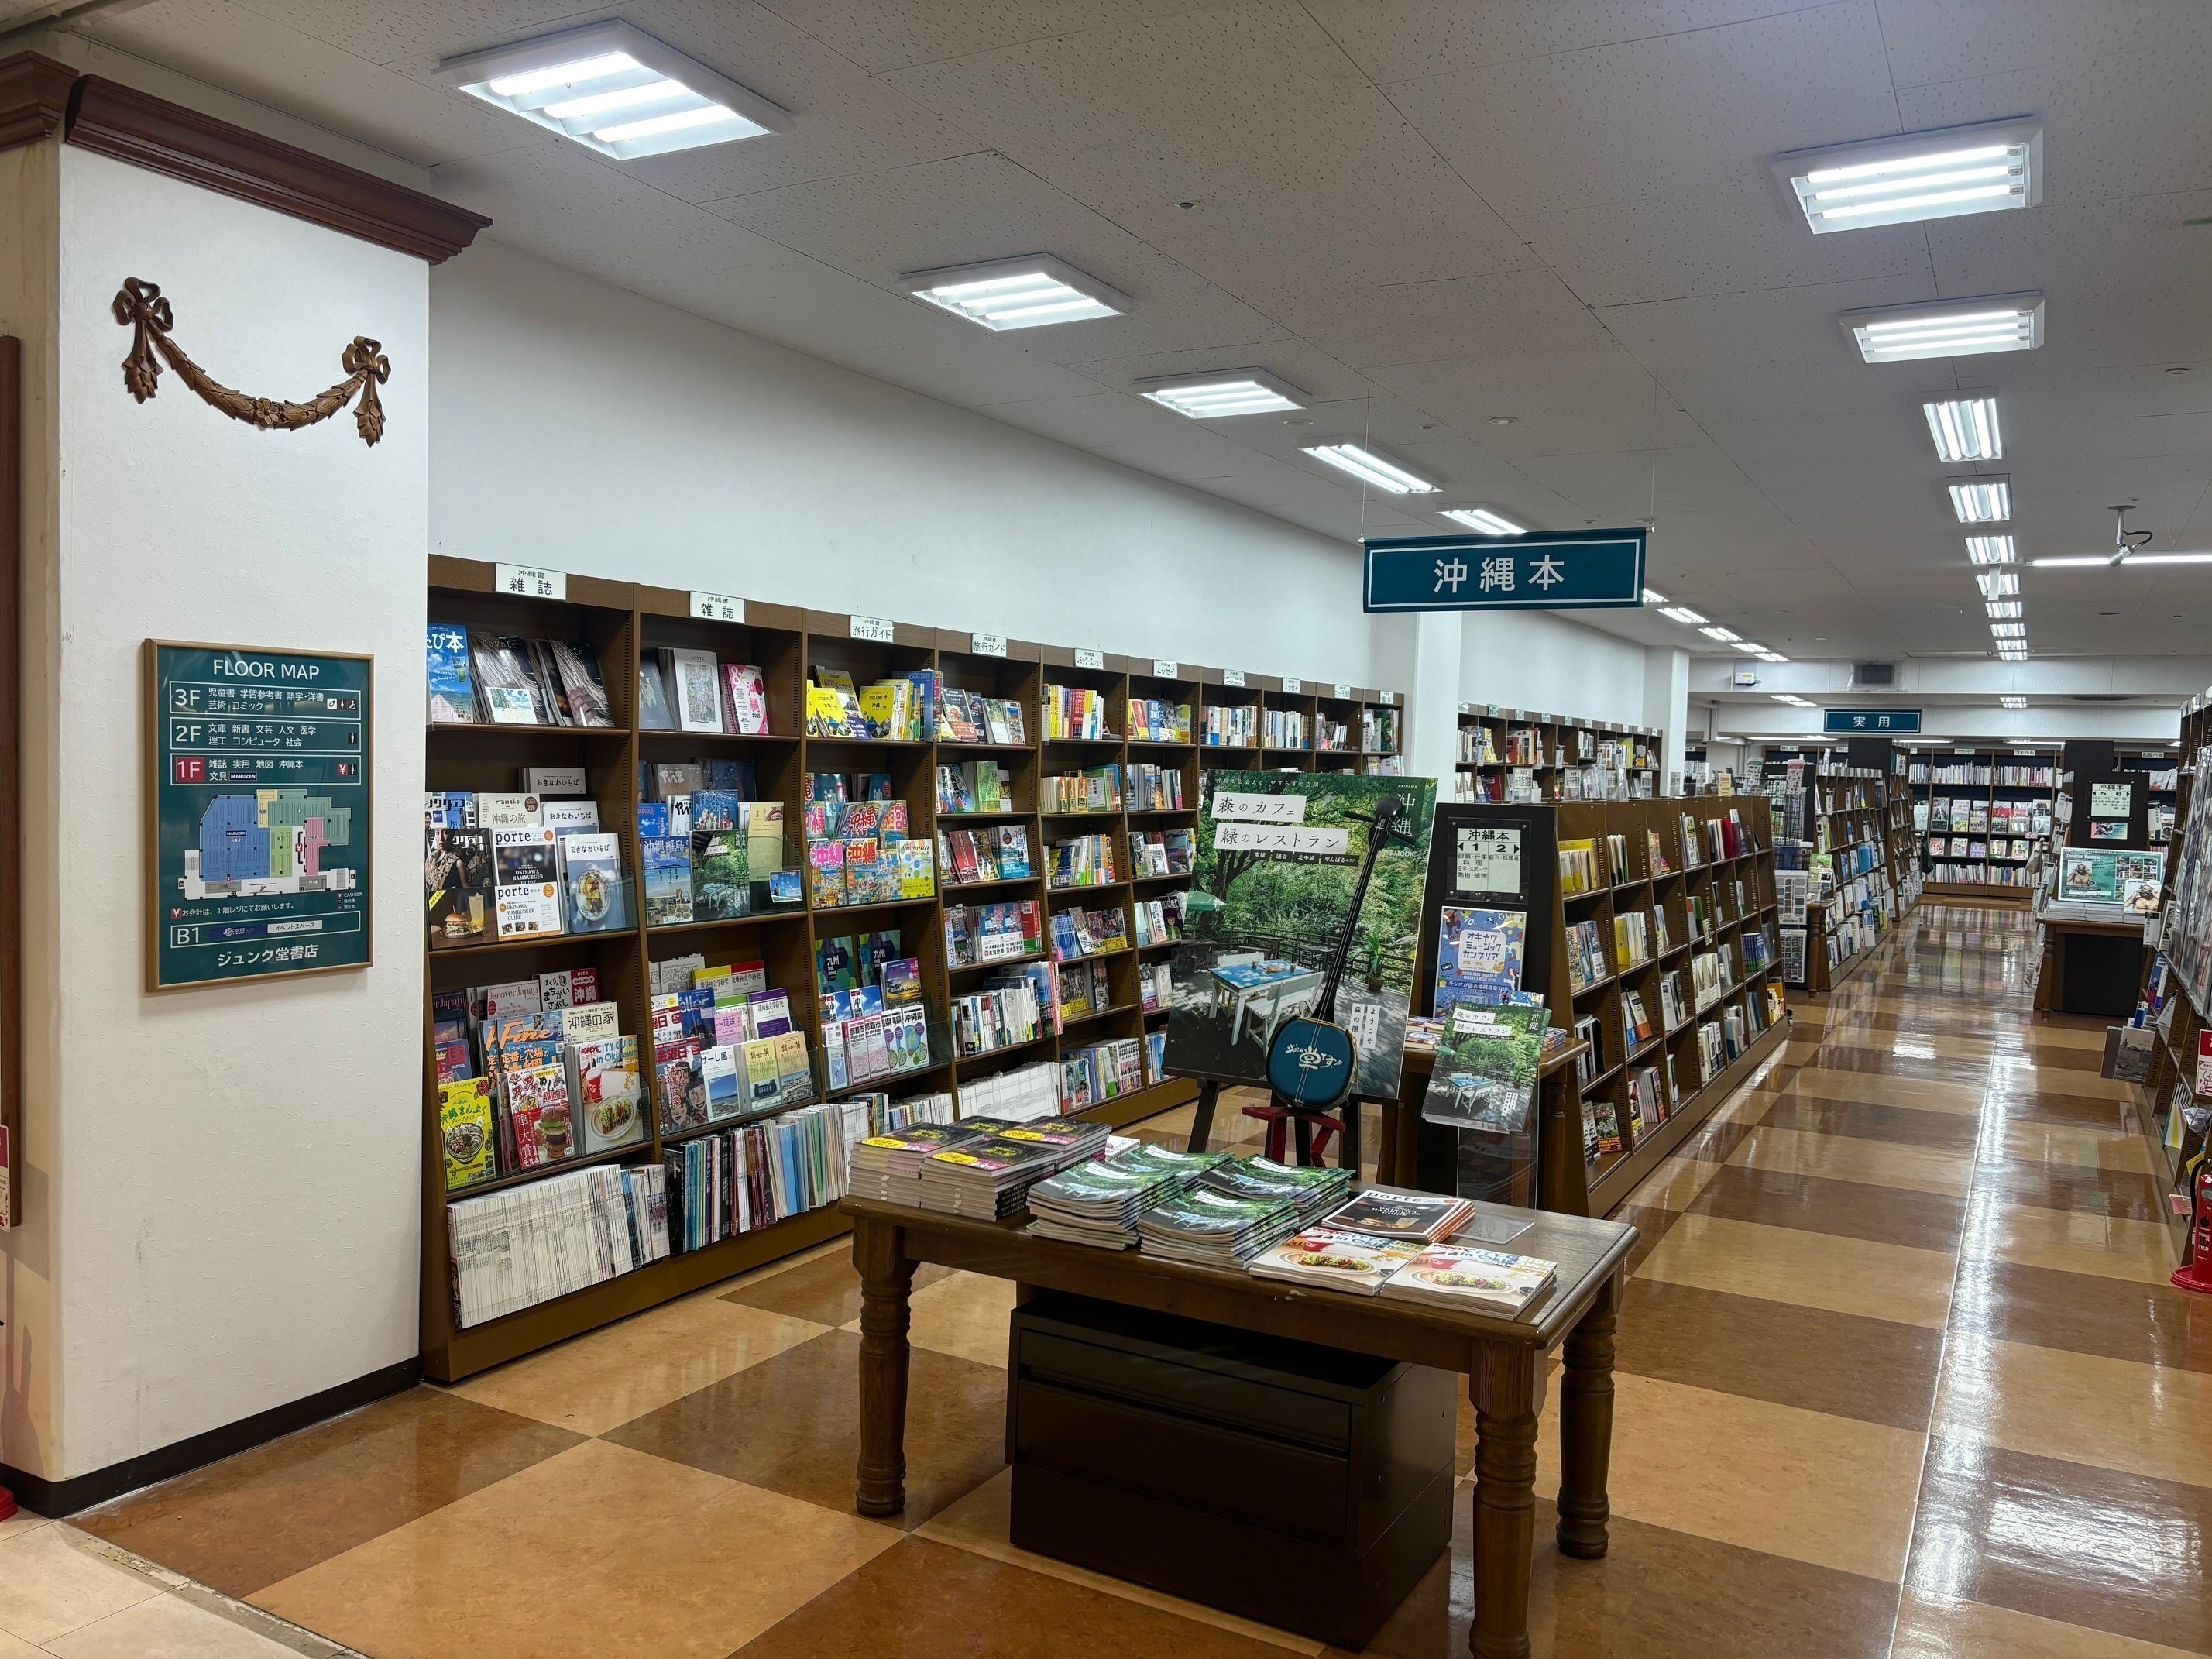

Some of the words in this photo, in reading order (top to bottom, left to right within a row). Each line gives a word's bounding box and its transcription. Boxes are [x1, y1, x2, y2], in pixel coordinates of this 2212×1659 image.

[1433, 555, 1565, 593] 沖縄本
[510, 576, 553, 596] 雑誌
[700, 603, 734, 619] 雑誌
[852, 625, 892, 640] 旅行ガイド
[974, 641, 1005, 654] 旅行ガイド
[213, 659, 276, 678] FLOOR
[281, 664, 320, 680] MAP
[1156, 667, 1175, 677] エッセイ
[175, 689, 201, 706] 3F
[208, 687, 235, 698] 児童書
[240, 689, 283, 700] 学習参考書
[287, 691, 325, 702] 語学・洋書
[208, 700, 227, 710] 芸術
[232, 701, 263, 711] コミック
[1853, 716, 1890, 729] 実用
[175, 725, 201, 743] 2F
[208, 723, 227, 733] 文庫
[232, 724, 250, 734] 新書
[256, 725, 273, 734] 文芸
[279, 726, 295, 735] 人文
[300, 726, 317, 735] 医学
[208, 736, 227, 746] 理工
[233, 737, 280, 747] コンピュータ
[285, 737, 302, 747] 社会
[177, 761, 201, 778] 1F
[208, 759, 227, 769] 雑誌
[232, 759, 250, 769] 実用
[256, 760, 273, 769] 地図
[279, 760, 304, 769] 沖縄本
[209, 771, 228, 781] 文具
[1217, 797, 1294, 816] 森のカフェ
[492, 813, 527, 825] 沖縄の旅
[550, 812, 592, 820] おきなわいちば
[1391, 793, 1417, 837] 沖縄
[495, 831, 531, 845] porte
[1220, 827, 1341, 849] 緑のレストラン
[1468, 830, 1510, 841] 沖縄本
[571, 844, 610, 854] おきなわいちば
[810, 841, 843, 866] 沖縄
[847, 841, 877, 865] 沖縄
[1496, 844, 1506, 853] 2
[498, 886, 530, 900] porte
[177, 926, 200, 945] B1
[276, 922, 315, 931] イベントスペース
[1467, 933, 1498, 943] オキナワ
[873, 948, 885, 959] 九州
[1465, 941, 1501, 952] ミュージック
[218, 944, 318, 967] ジュンク堂書店
[826, 955, 840, 967] 九州
[1462, 950, 1499, 960] カンブリア
[489, 989, 516, 1000] Discover
[517, 986, 538, 998] Japan
[544, 987, 570, 1001] まちがい
[574, 985, 596, 1002] 沖縄
[439, 997, 463, 1008] Japan
[548, 999, 569, 1010] さがし
[568, 1012, 615, 1029] 沖縄の家
[904, 1012, 924, 1022] 沖縄県
[1528, 1013, 1541, 1031] 沖縄
[850, 1025, 864, 1036] 那覇市
[865, 1020, 881, 1031] 那覇市
[1366, 1008, 1376, 1045] ようこそ
[500, 1020, 554, 1050] Fine
[581, 1046, 599, 1055] POPEYE
[598, 1042, 614, 1053] CITY
[615, 1038, 637, 1049] GUIDE
[502, 1048, 549, 1064] 定番と穴場の
[657, 1049, 687, 1063] 金曜日
[542, 1090, 567, 1103] AWARD
[517, 1115, 532, 1158] 準大賞
[1366, 1191, 1422, 1203] porte
